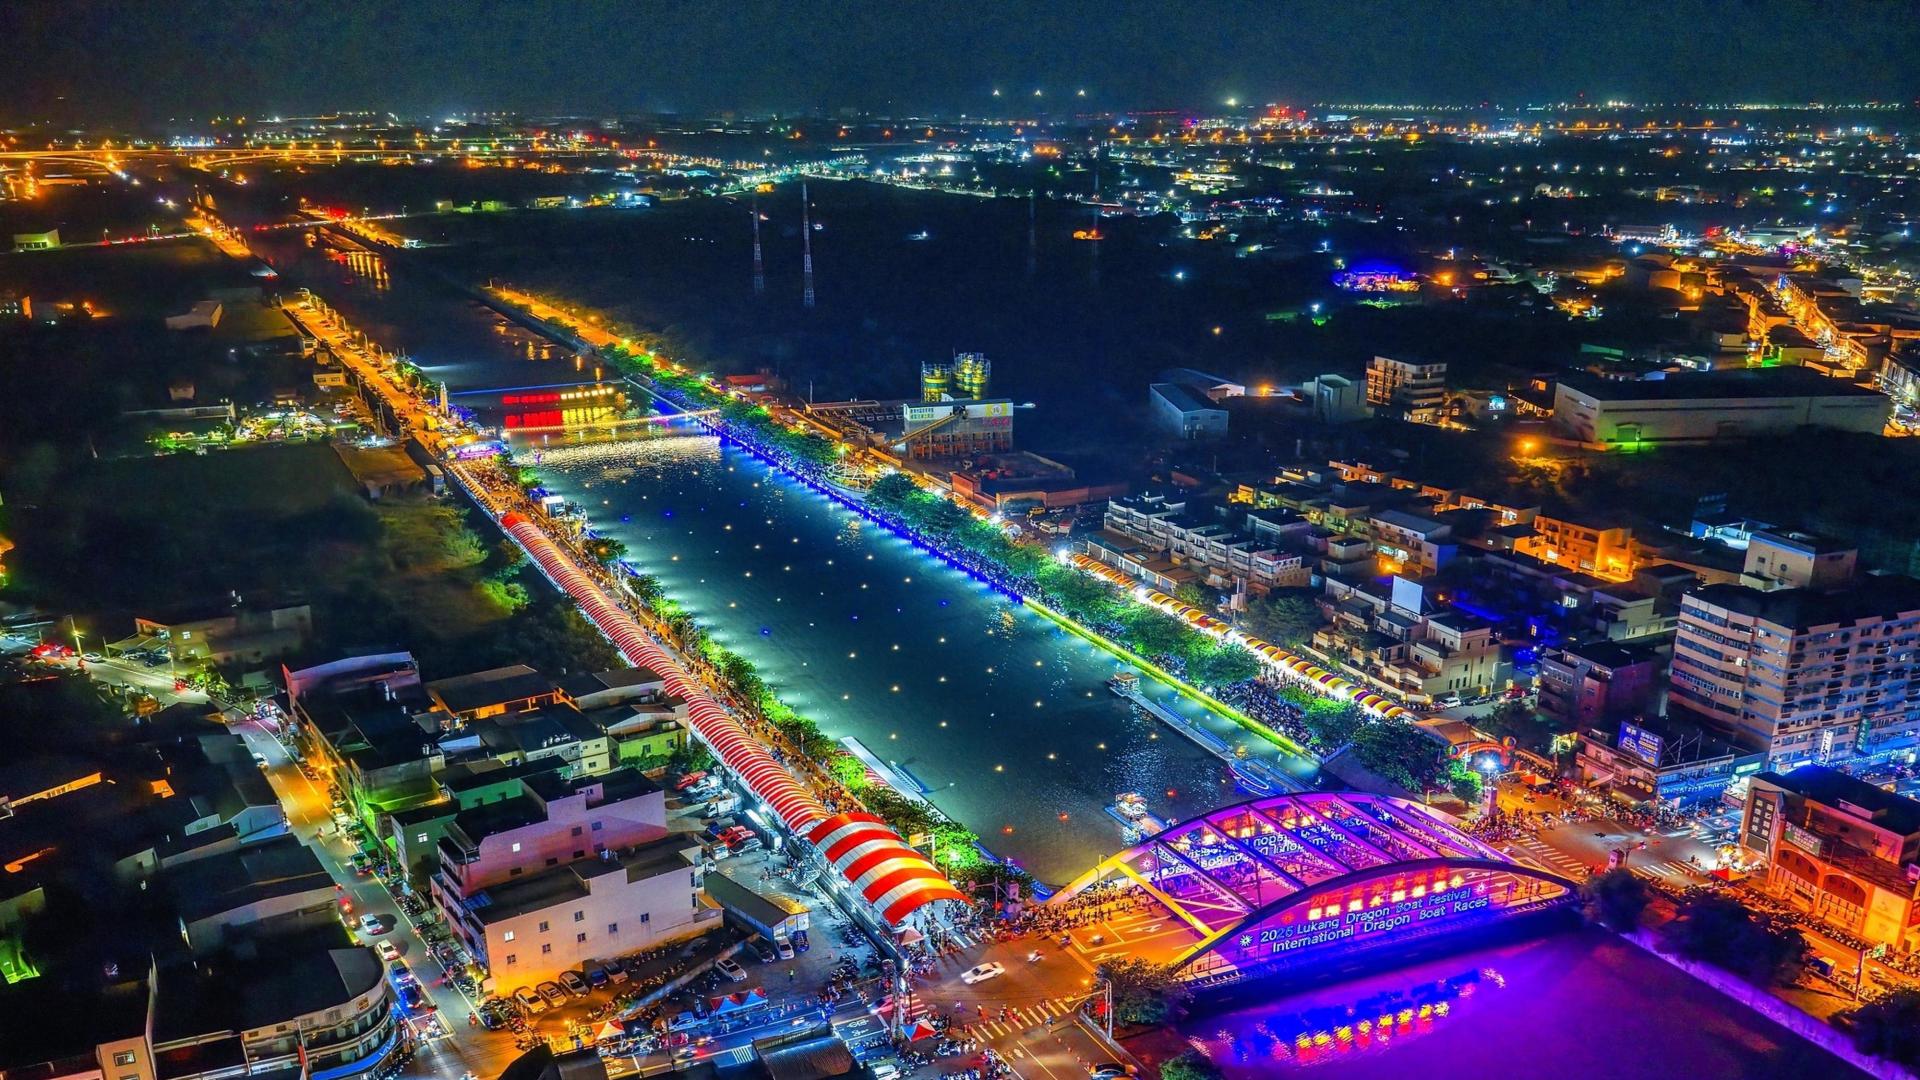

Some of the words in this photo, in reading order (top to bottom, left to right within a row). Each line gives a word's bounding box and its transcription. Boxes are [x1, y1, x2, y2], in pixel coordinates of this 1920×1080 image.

[1272, 925, 1354, 953] International
[1364, 914, 1411, 932] Dragon
[1419, 906, 1446, 920] Boat
[1453, 897, 1488, 913] Races
[1297, 919, 1340, 934] Lukang
[1345, 907, 1390, 924] Dragon
[1395, 899, 1423, 913] Boat
[1428, 888, 1471, 905] Festival
